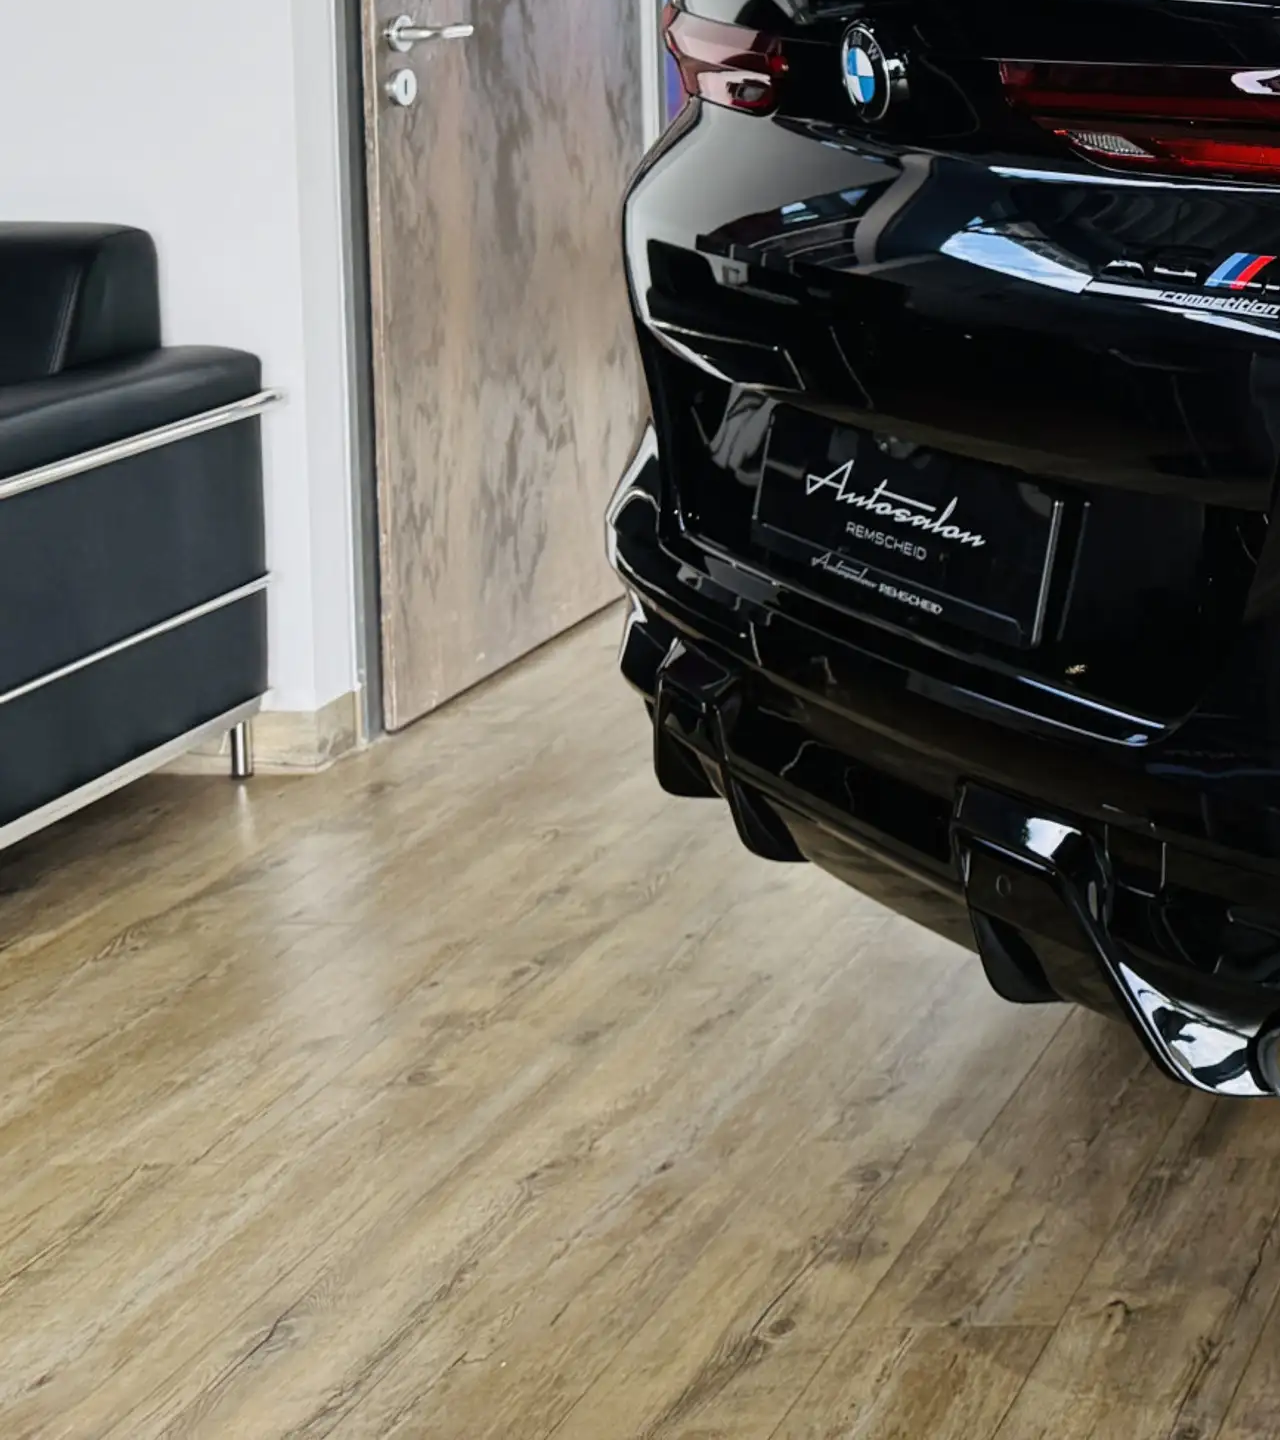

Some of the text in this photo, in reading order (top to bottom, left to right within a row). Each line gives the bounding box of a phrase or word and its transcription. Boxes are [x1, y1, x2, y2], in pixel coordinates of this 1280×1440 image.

[806, 459, 985, 547] Autosalon
[846, 521, 928, 561] REMSCHEID
[878, 583, 943, 615] REMSCHEID
